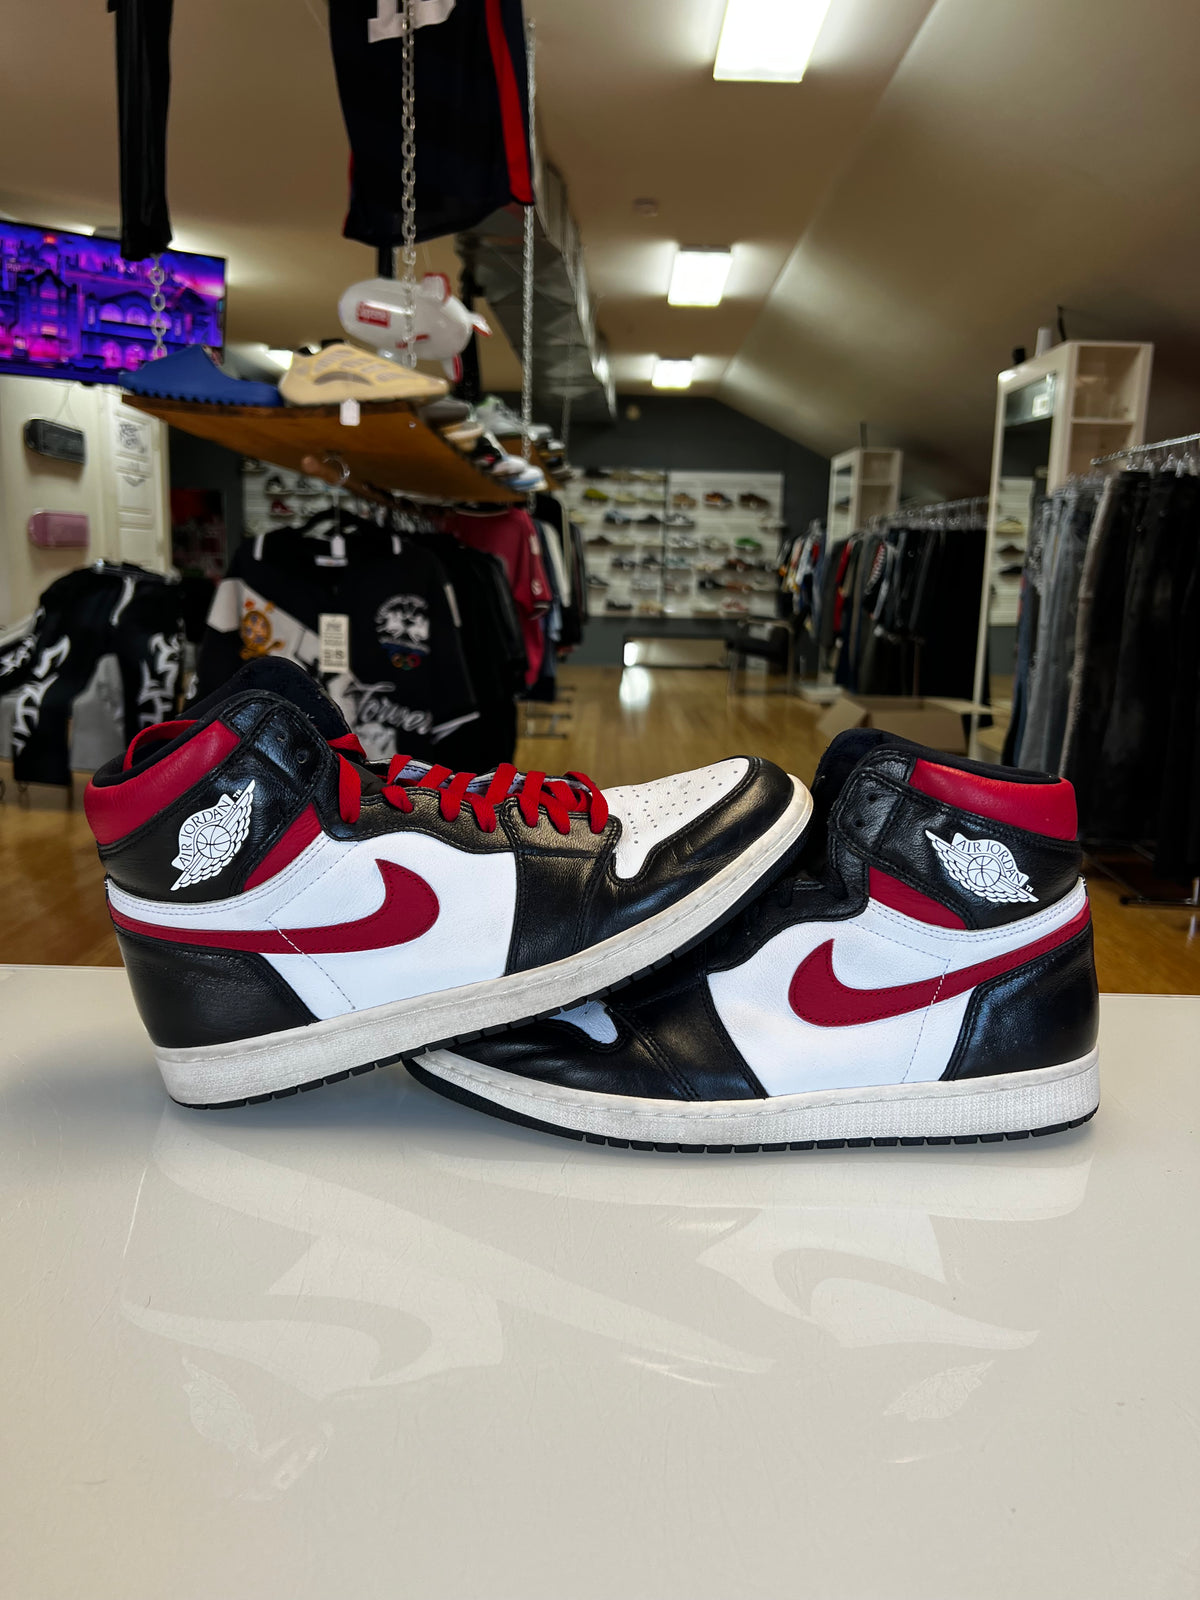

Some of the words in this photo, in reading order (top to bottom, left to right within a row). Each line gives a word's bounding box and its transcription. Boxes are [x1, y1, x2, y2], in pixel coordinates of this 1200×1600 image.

[180, 800, 231, 838] JORDAN
[179, 843, 193, 867] AIR
[956, 839, 982, 853] AIR
[986, 840, 1024, 884] JORDAN
